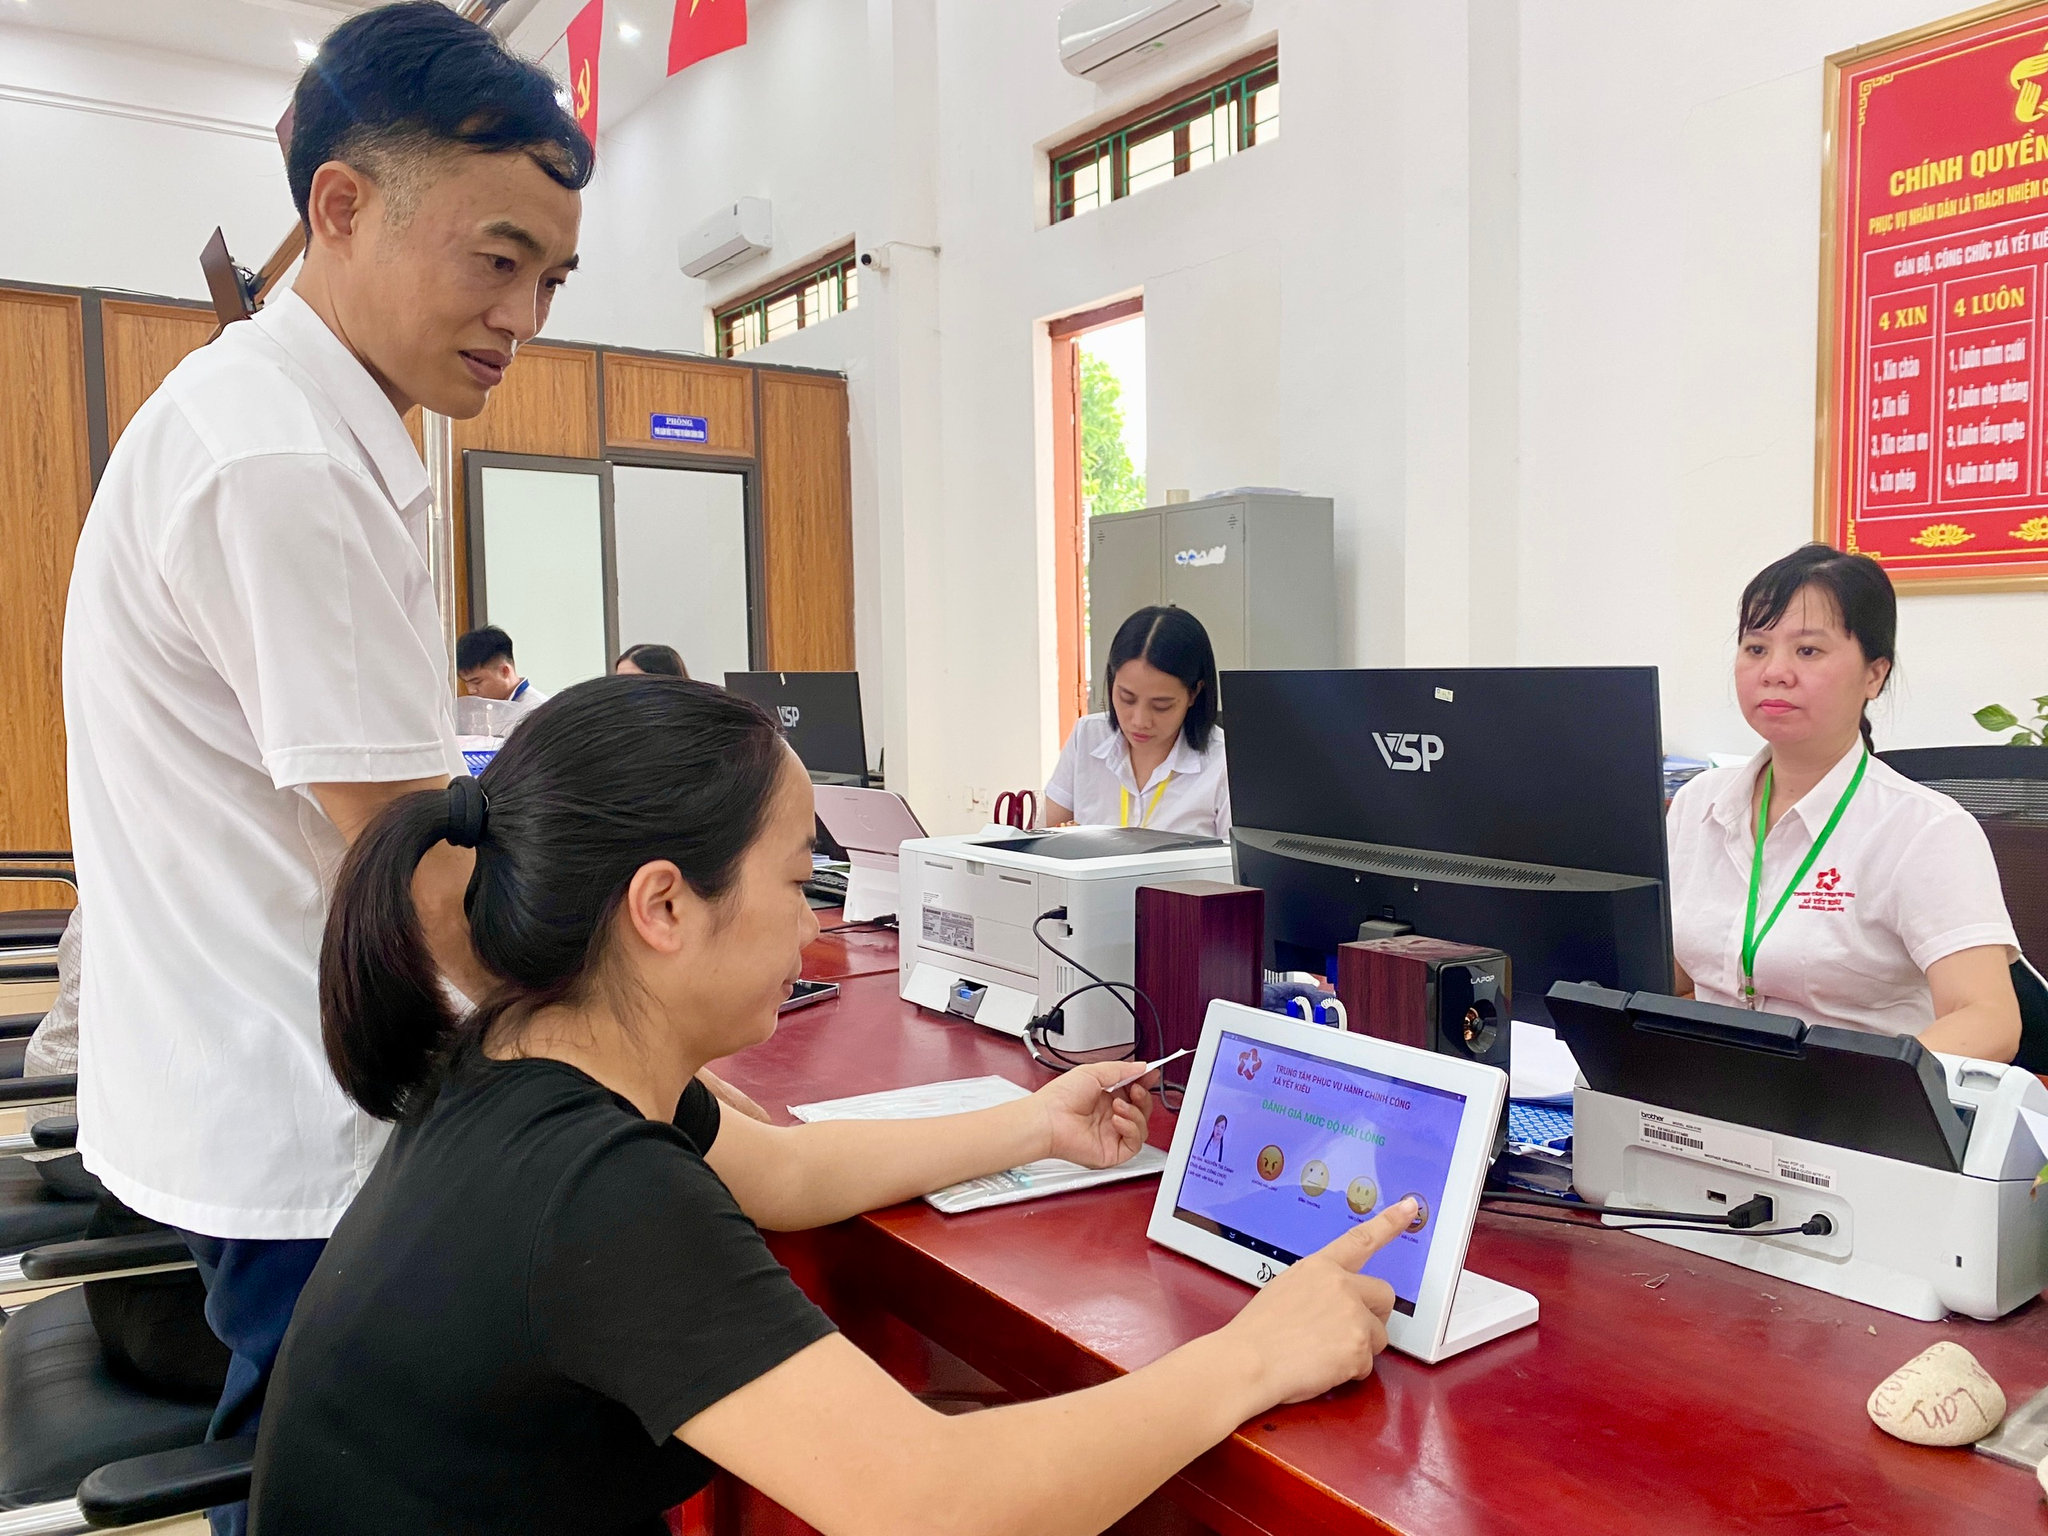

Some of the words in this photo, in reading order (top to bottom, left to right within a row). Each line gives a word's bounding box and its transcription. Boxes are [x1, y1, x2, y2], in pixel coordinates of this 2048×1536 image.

[1890, 155, 1963, 196] CHÍNH
[1869, 215, 1893, 235] PHỤC
[1896, 211, 1907, 230] VỤ
[1909, 203, 1935, 226] NHÂN
[1937, 198, 1957, 219] DÂN
[1959, 193, 1970, 214] LÀ
[1973, 188, 2005, 210] TRÁCH
[2007, 179, 2039, 203] NHIỆM
[1895, 256, 1916, 278] CÁN
[1936, 248, 1962, 269] CÔNG
[1965, 240, 1992, 264] CHỨC
[1994, 236, 2008, 257] XÃ
[2012, 229, 2031, 254] YẾT
[1879, 312, 1890, 330] 4
[1895, 304, 1928, 329] XIN
[1954, 299, 1966, 318] 4
[1972, 285, 2026, 314] LUÔN
[776, 706, 799, 727] VSP
[1372, 732, 1444, 772] VSP
[1272, 1076, 1281, 1085] XÃ
[1281, 1078, 1293, 1088] YẾT
[1295, 1082, 1310, 1094] KIÊU
[1276, 1064, 1297, 1078] TRUNG
[1299, 1071, 1312, 1082] TÂM
[1312, 1075, 1331, 1087] PHỤC
[1333, 1080, 1343, 1091] VỤ
[1344, 1083, 1364, 1096] HÀNH
[1365, 1089, 1388, 1104] CHÍNH
[1389, 1095, 1411, 1110] CÔNG
[1262, 1098, 1286, 1115] ĐÁNH
[1288, 1105, 1301, 1118] GIÁ
[1304, 1111, 1325, 1127] MỨC
[1326, 1118, 1340, 1133] ĐỘ
[1341, 1124, 1358, 1137] HÀI
[1360, 1128, 1385, 1147] LÒNG
[1641, 1111, 1664, 1122] brother
